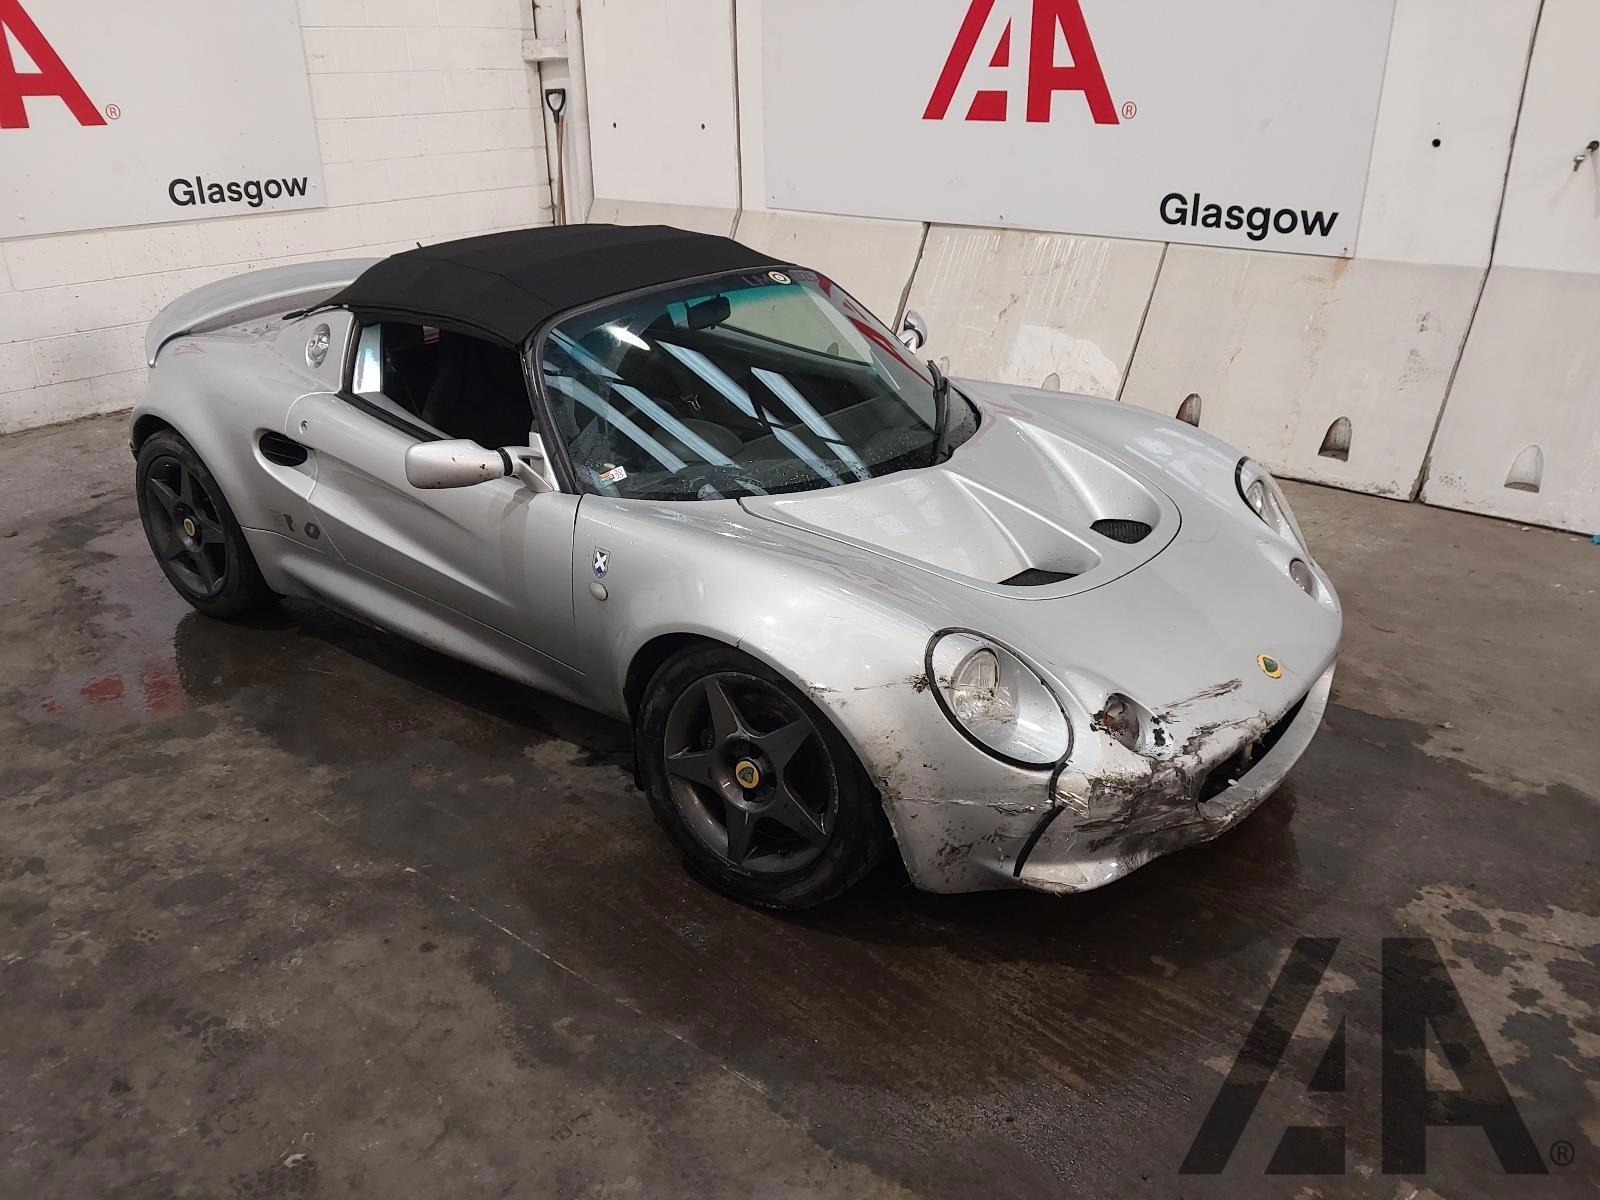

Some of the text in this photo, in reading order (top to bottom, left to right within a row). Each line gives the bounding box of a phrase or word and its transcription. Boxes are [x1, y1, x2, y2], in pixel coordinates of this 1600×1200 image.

[922, 0, 1120, 125] AA
[168, 175, 308, 208] Glasgow
[1159, 192, 1340, 241] Glasgow
